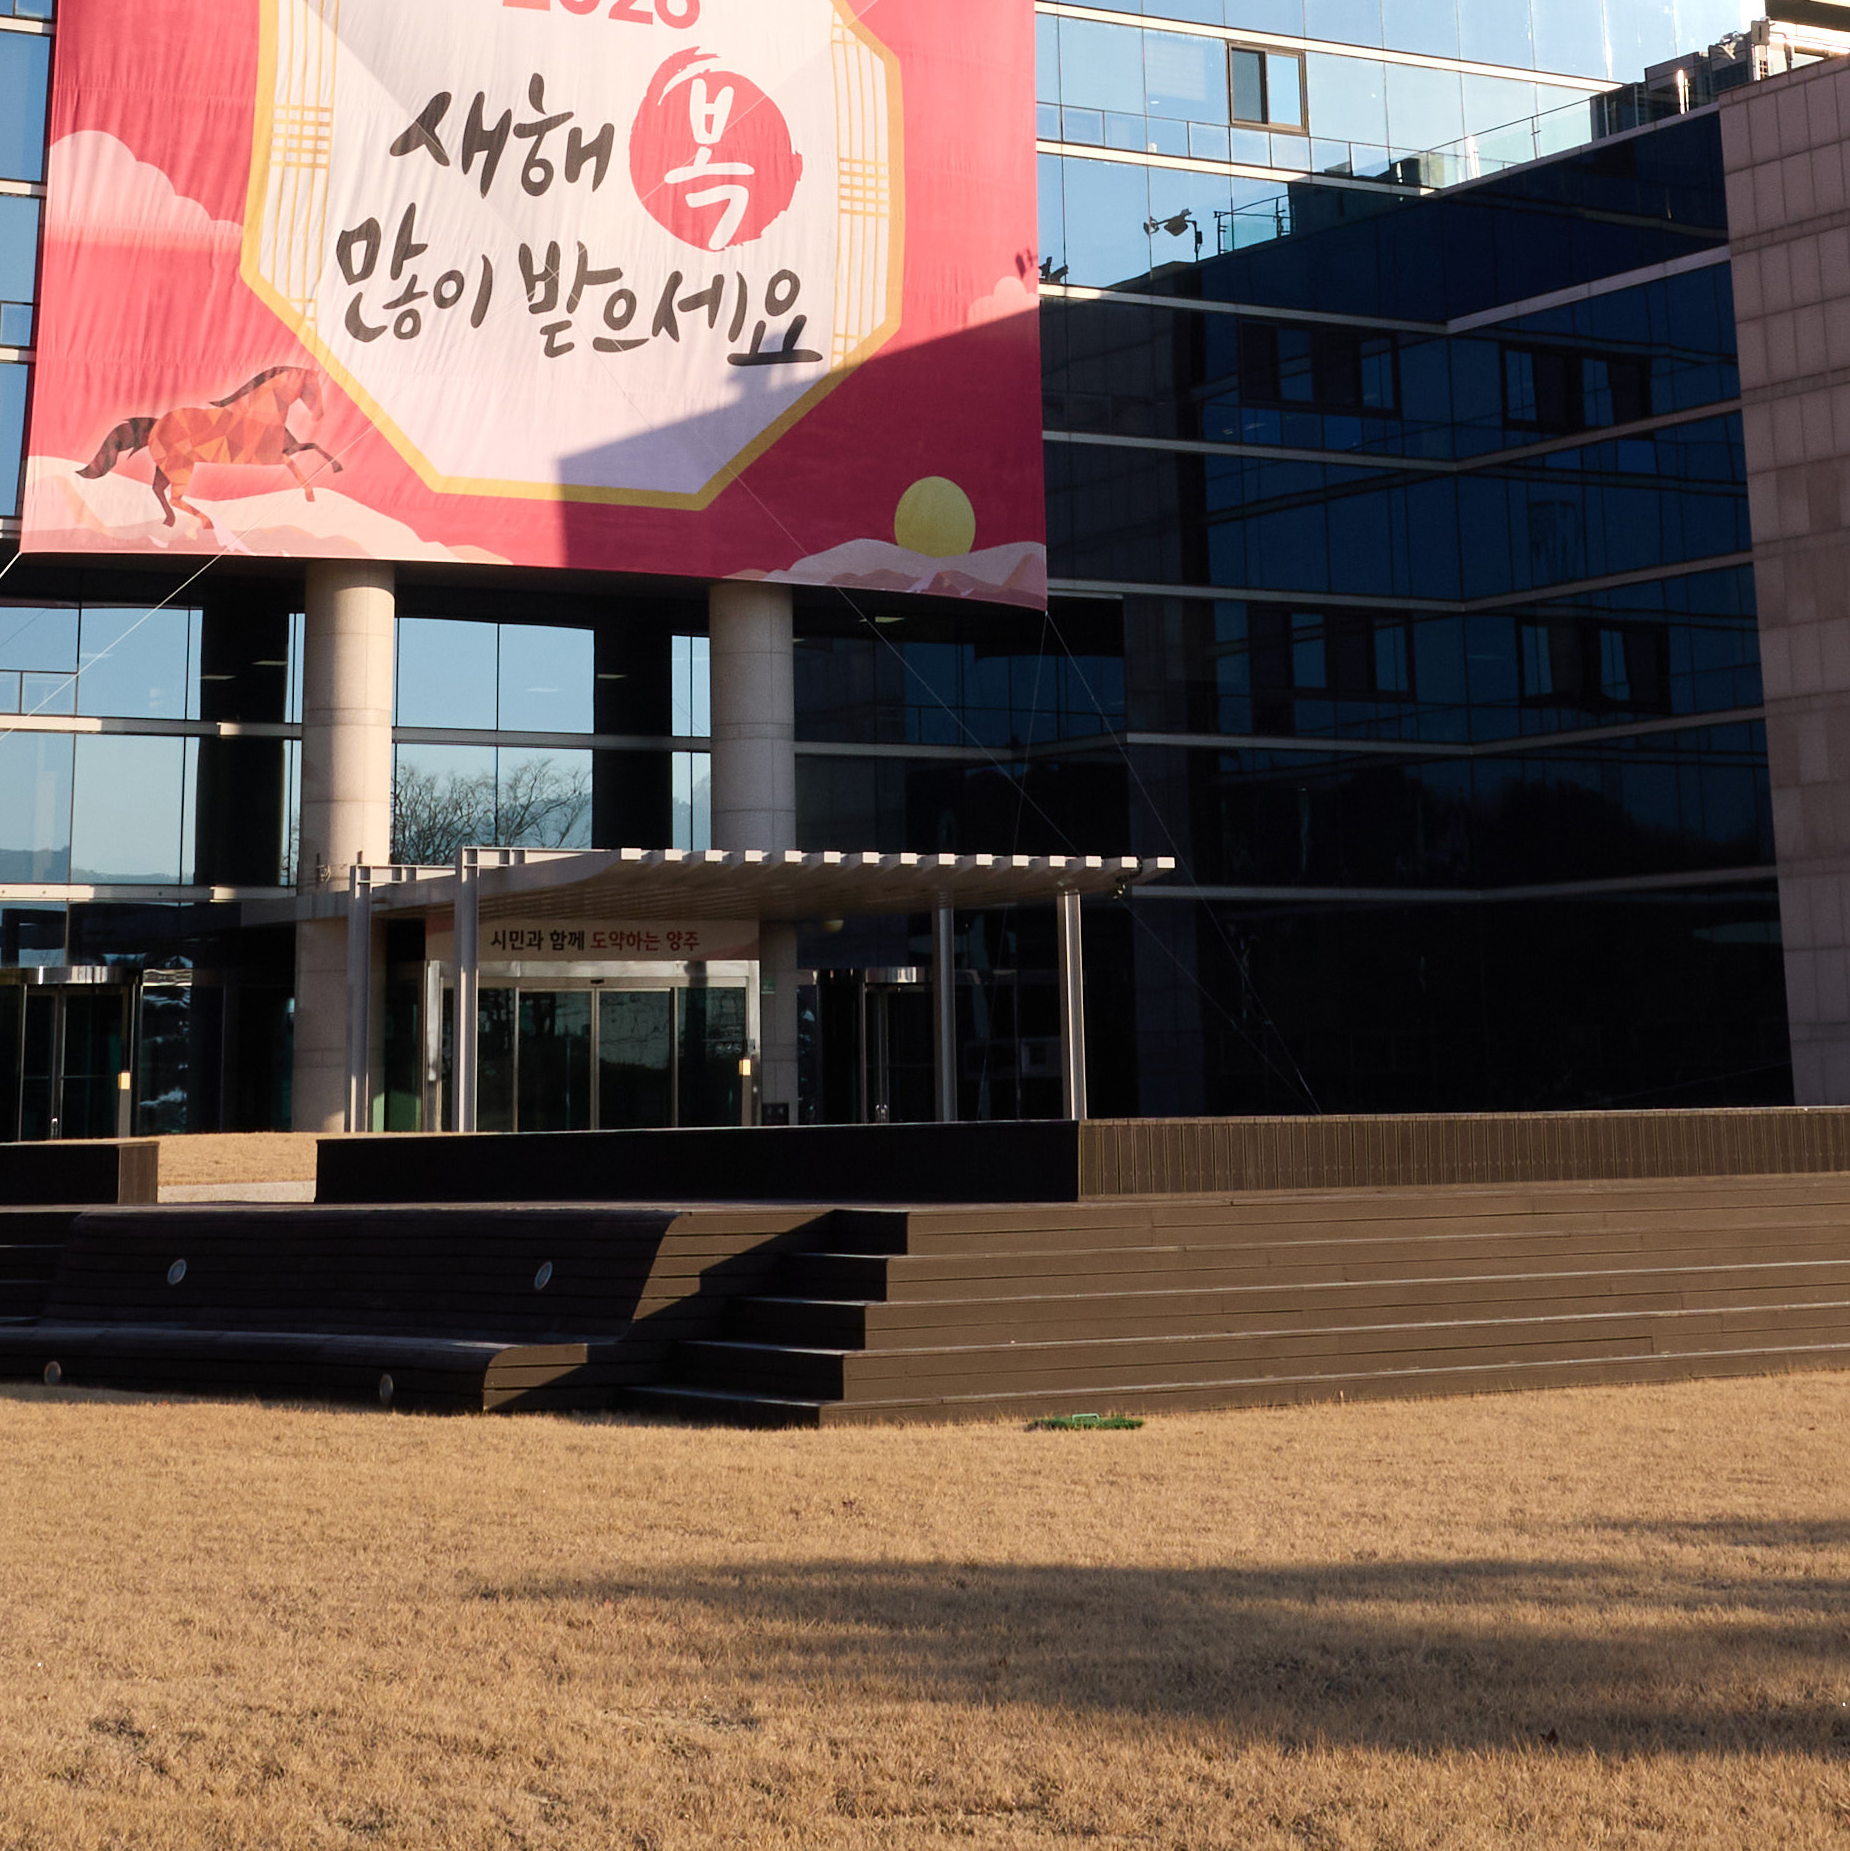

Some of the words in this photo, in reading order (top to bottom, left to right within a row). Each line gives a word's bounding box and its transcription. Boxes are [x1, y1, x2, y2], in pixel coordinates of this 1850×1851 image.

[389, 72, 614, 198] 새해
[663, 76, 756, 251] 복
[335, 202, 493, 343] 많이
[519, 239, 824, 365] 받으세요
[491, 930, 544, 950] 시민과
[549, 930, 585, 950] 함께
[590, 930, 661, 950] 도약하는
[666, 931, 700, 951] 양주
